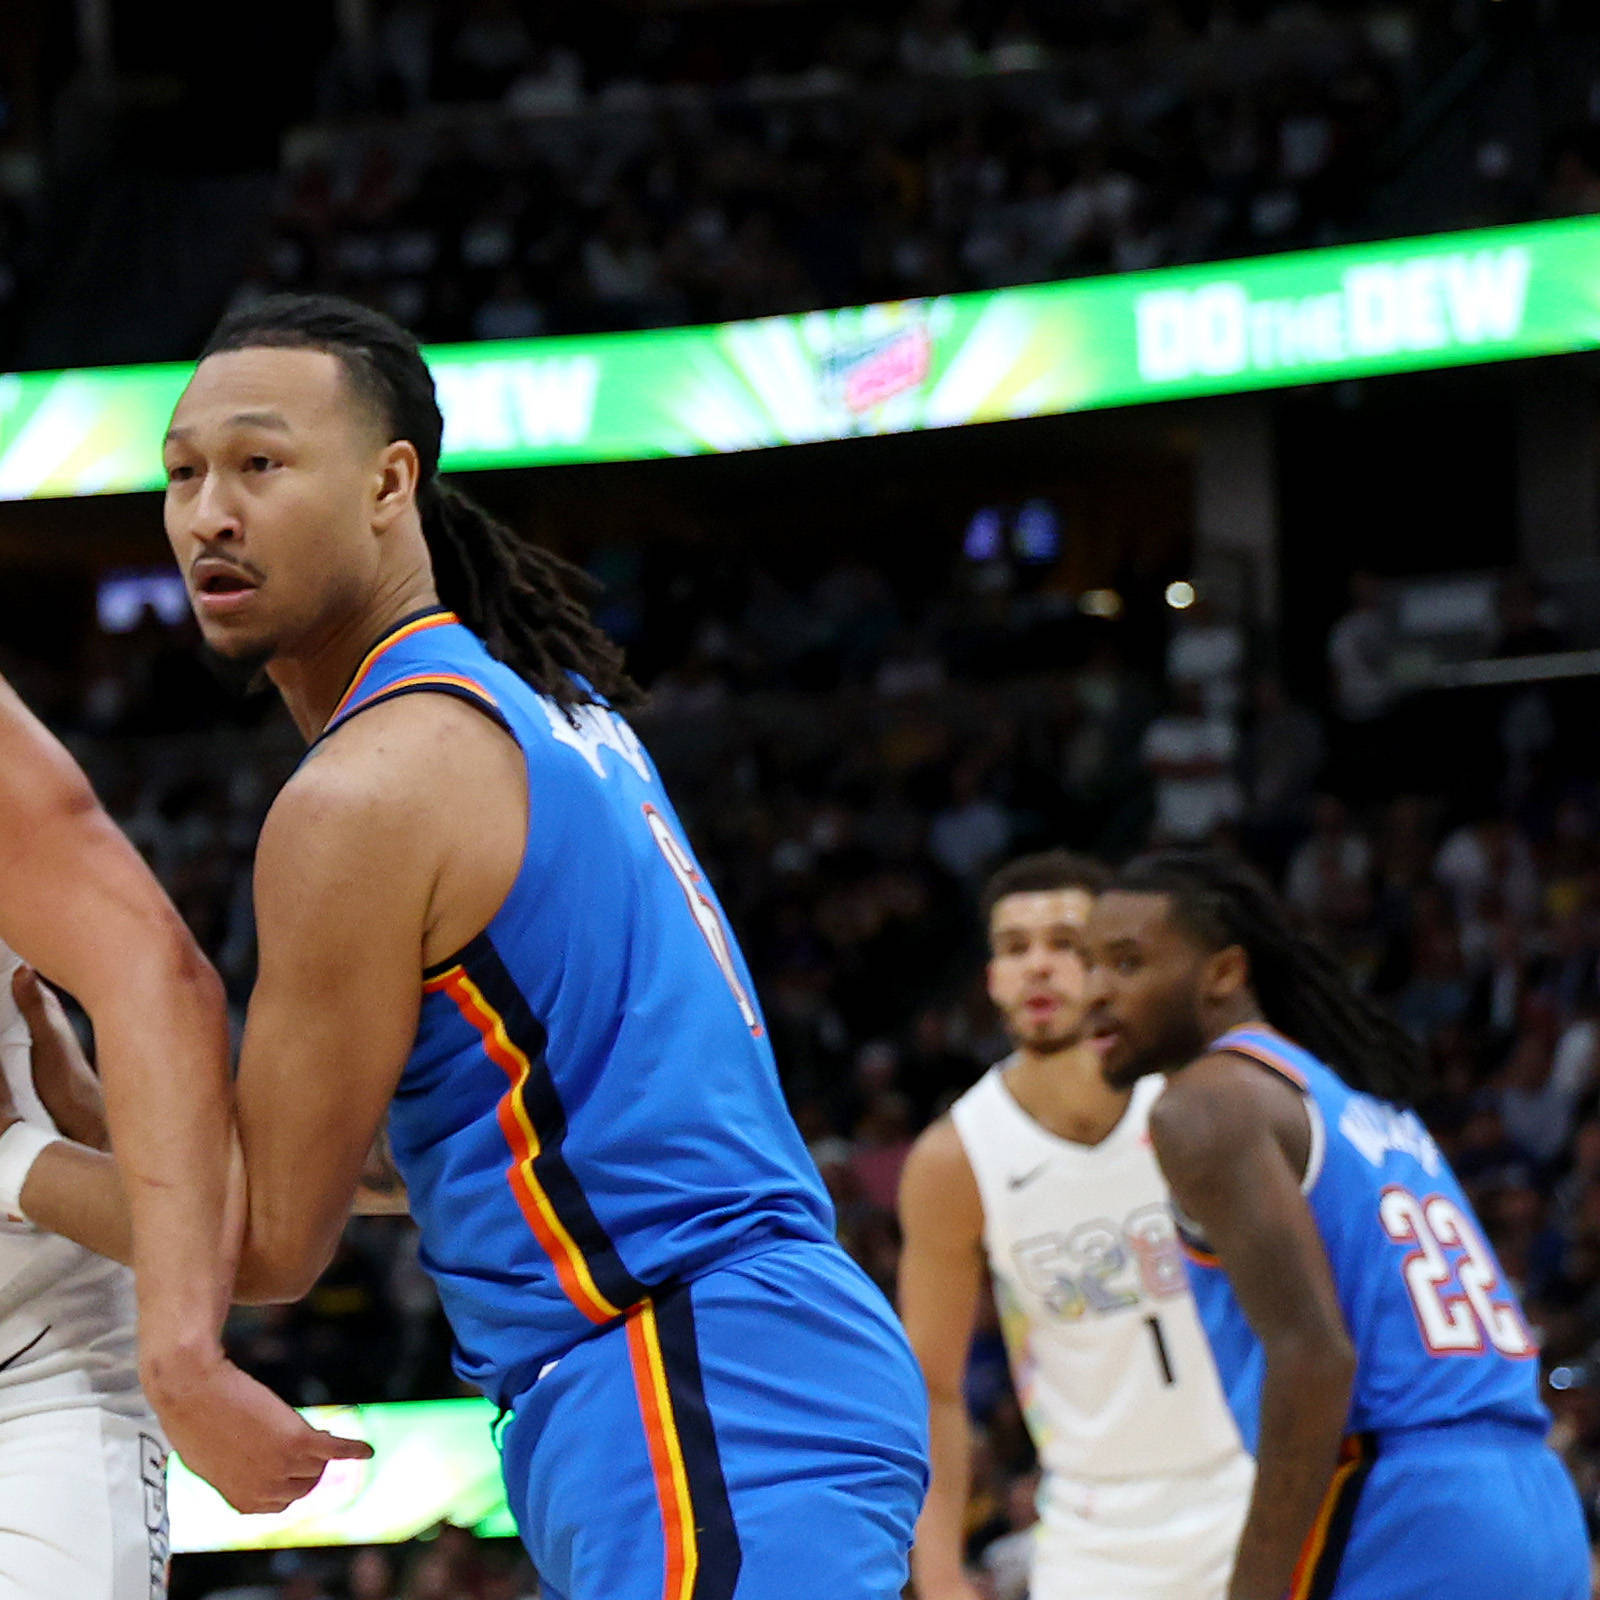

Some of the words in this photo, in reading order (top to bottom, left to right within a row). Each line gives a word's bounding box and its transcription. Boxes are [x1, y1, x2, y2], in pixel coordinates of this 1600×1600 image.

[1135, 281, 1247, 383] DO
[1342, 246, 1532, 358] DEW
[1378, 1183, 1540, 1358] 22
[1144, 1312, 1177, 1388] 1
